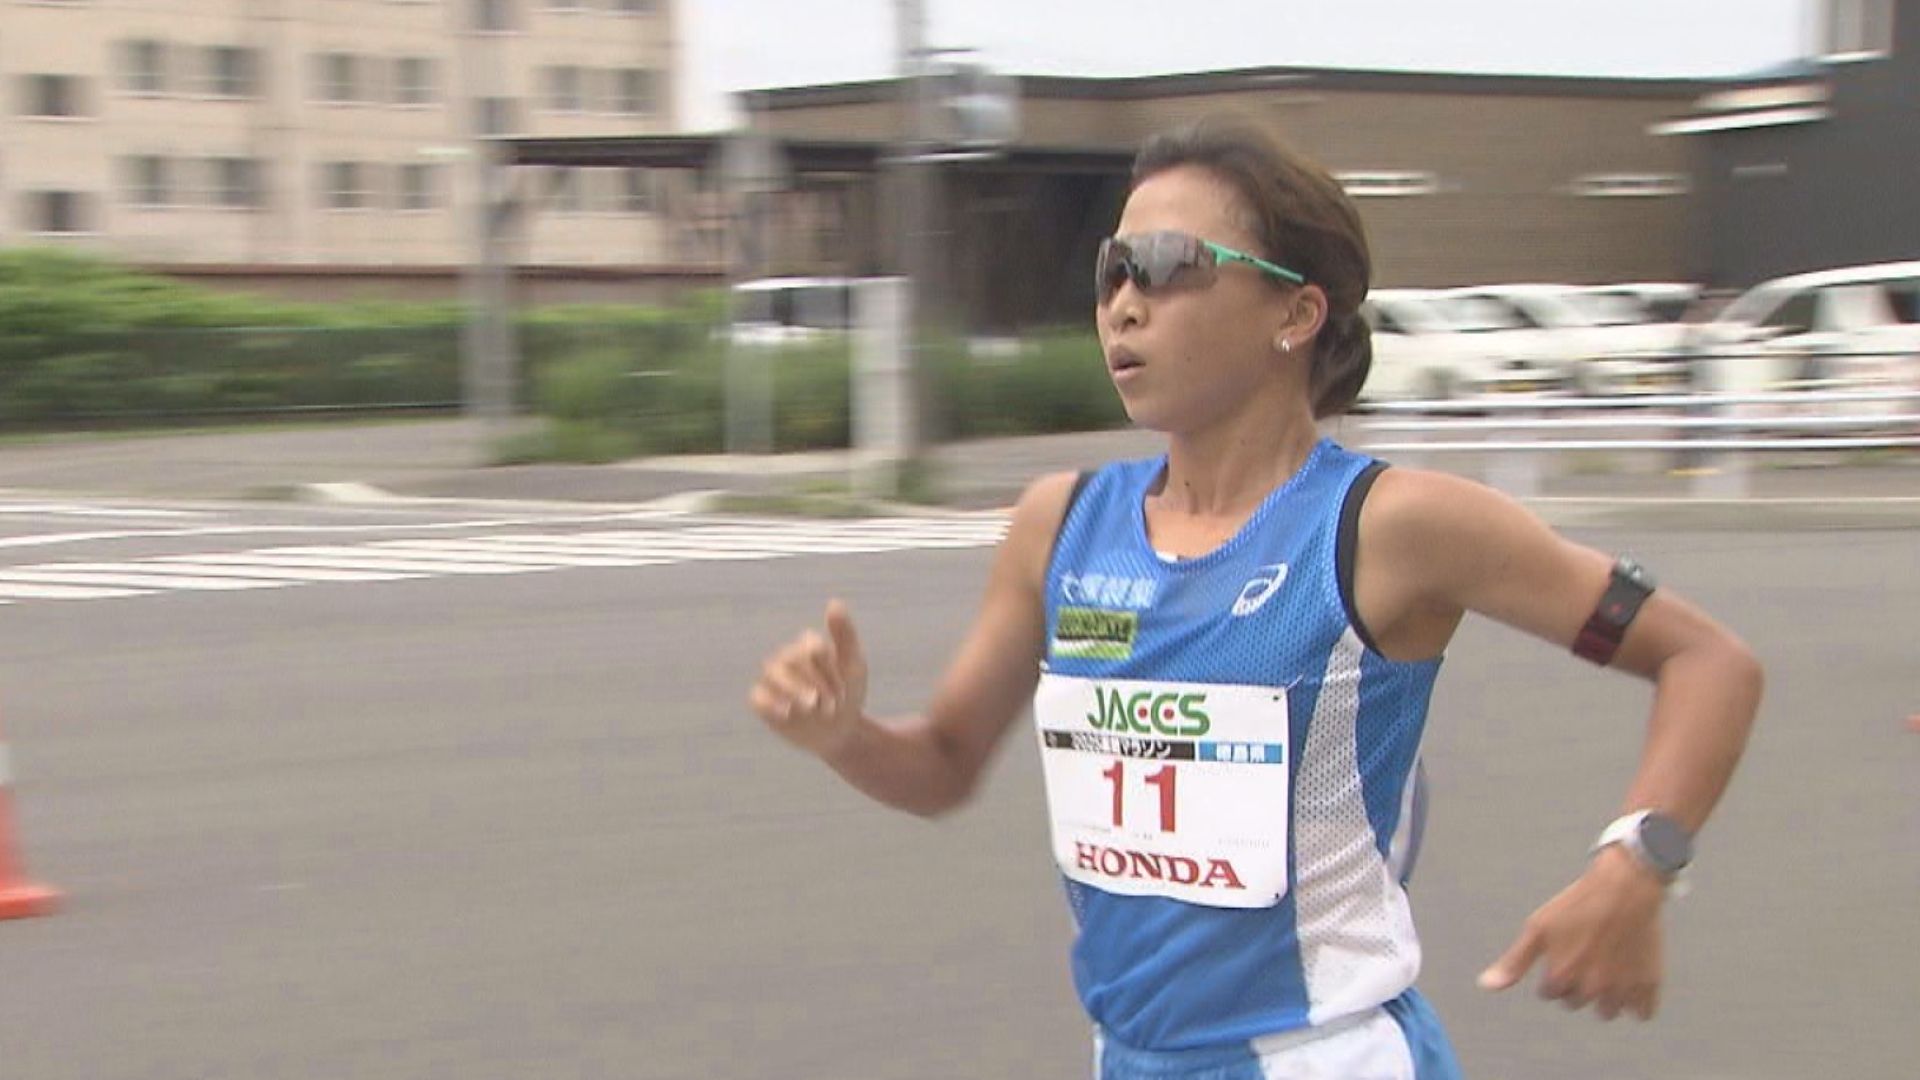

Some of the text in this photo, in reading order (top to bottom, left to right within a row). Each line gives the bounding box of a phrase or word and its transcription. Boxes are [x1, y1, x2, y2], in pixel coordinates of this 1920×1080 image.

[1087, 686, 1210, 736] JACCS
[1102, 760, 1177, 833] 11
[1075, 842, 1246, 890] HONDA
